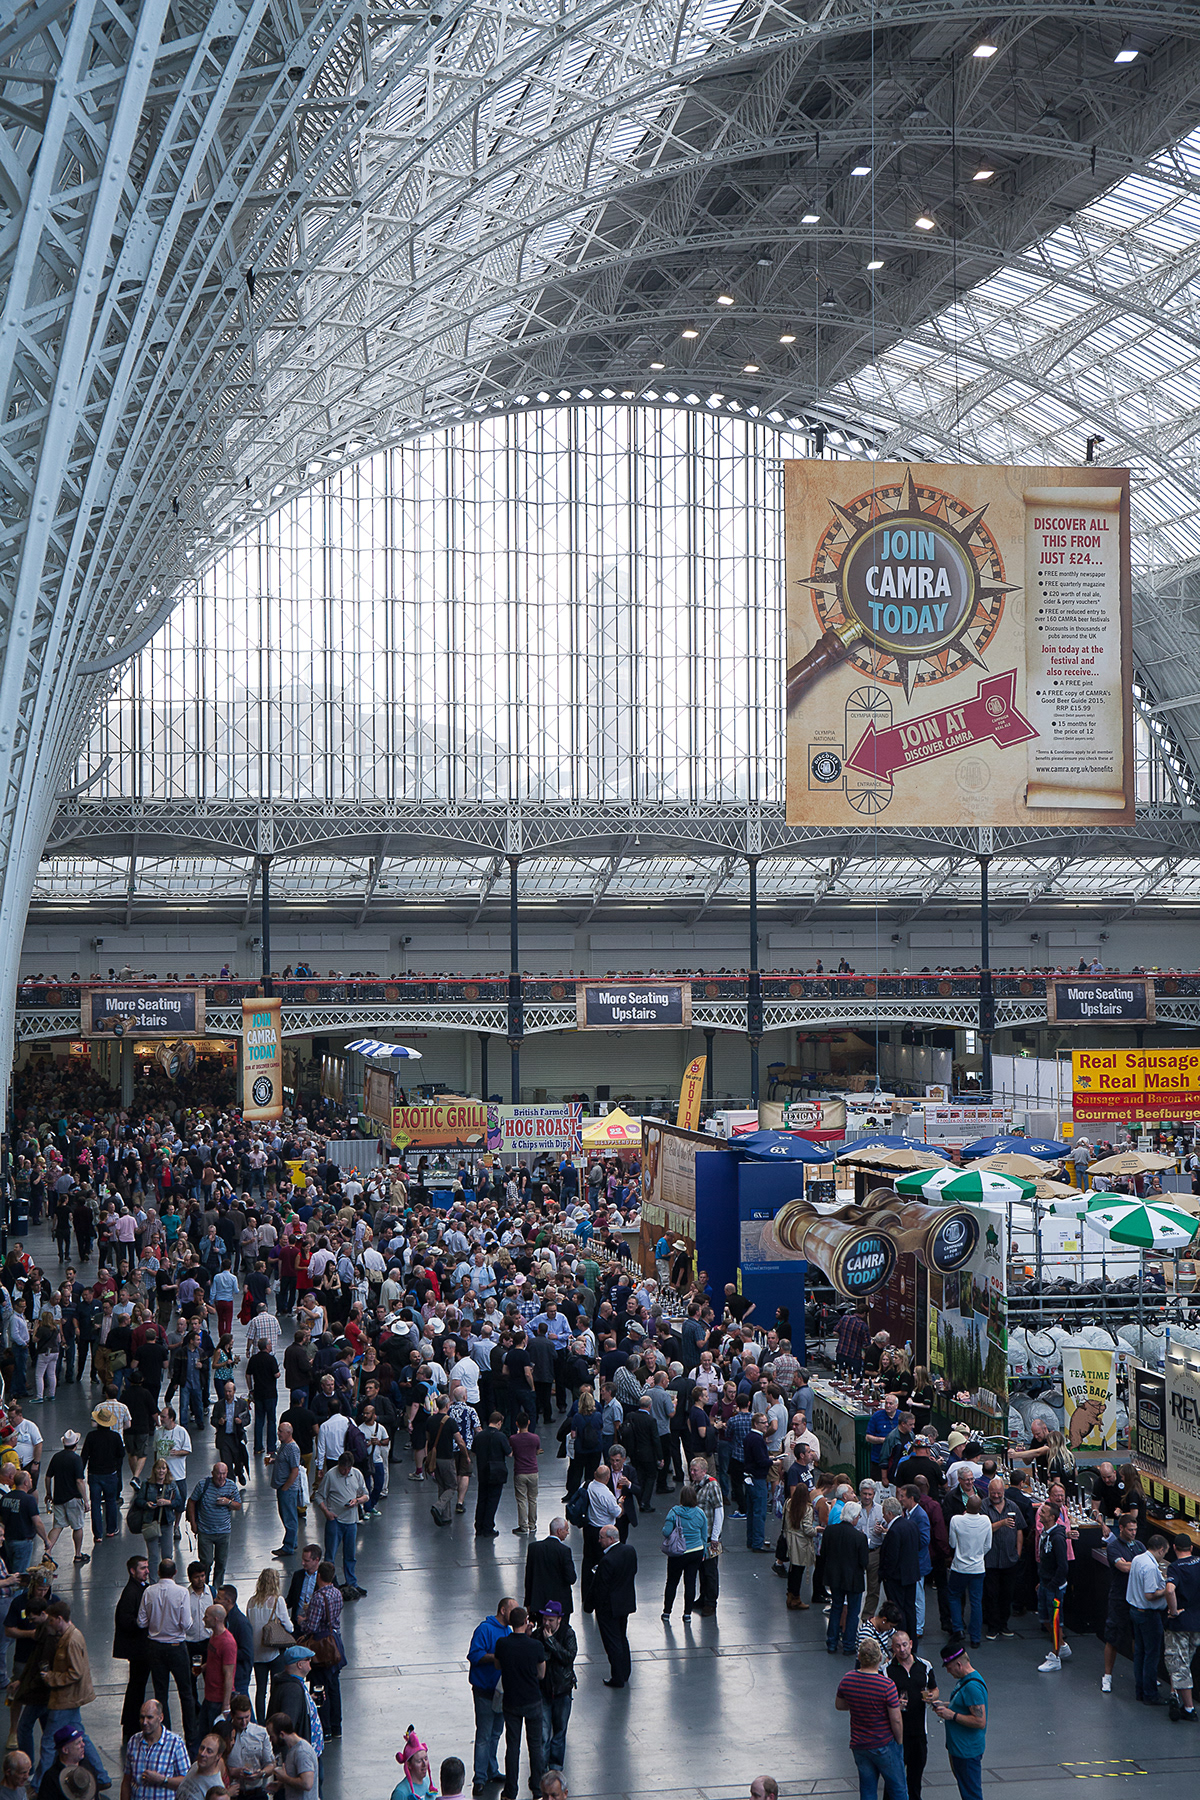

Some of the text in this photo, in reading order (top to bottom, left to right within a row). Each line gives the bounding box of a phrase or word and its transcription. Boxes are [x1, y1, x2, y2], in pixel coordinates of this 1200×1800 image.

[1034, 518, 1109, 531] DISCOVER ALL
[881, 530, 934, 560] JOIN
[1042, 535, 1100, 548] THIS FROM
[1040, 552, 1102, 564] JUST £24...
[865, 566, 952, 598] CAMRA
[868, 600, 949, 634] TODAY
[1042, 645, 1056, 653] Join
[1058, 645, 1079, 655] today
[1091, 645, 1104, 653] the
[1051, 656, 1095, 664] festival and
[1064, 668, 1099, 676] receive...
[992, 714, 1009, 723] CAMPAIGN
[899, 708, 967, 750] JOIN AT
[904, 730, 974, 762] DISCOVER CAMRA
[814, 754, 838, 765] DISCOVER
[1036, 766, 1114, 774] www.camra.org.uk/benefits
[599, 992, 668, 1006] More Seating
[1068, 988, 1134, 1002] More Seating
[106, 998, 181, 1013] More Seating
[1080, 1002, 1122, 1016] Upstairs
[252, 1012, 271, 1028] JOIN
[612, 1007, 656, 1021] Upstairs
[247, 1028, 277, 1045] CAMRA
[248, 1044, 276, 1060] TODAY
[1080, 1054, 1199, 1070] Real Sausage
[1100, 1073, 1190, 1088] Real Mash
[688, 1081, 696, 1109] HOT
[1076, 1093, 1200, 1106] Sausage and Bacon Ro
[393, 1107, 486, 1128] EXOTIC GRILL
[1076, 1109, 1200, 1120] Gourmet Beefburge
[505, 1118, 577, 1136] HOG ROAST
[518, 1140, 537, 1150] Chips
[555, 1140, 571, 1149] Dips
[770, 1146, 789, 1154] 6X
[1030, 1144, 1050, 1153] 6X
[856, 1240, 880, 1255] JOIN
[944, 1242, 963, 1251] CAMPAIGN
[847, 1253, 885, 1271] CAMRA
[847, 1268, 883, 1285] TODAY
[1087, 1371, 1110, 1380] TIME
[1066, 1385, 1113, 1401] HOGS BACK
[1183, 1384, 1194, 1394] THE
[1140, 1409, 1160, 1426] BRAINS
[825, 1412, 842, 1456] BACK
[1139, 1435, 1165, 1462] LEGENDS
